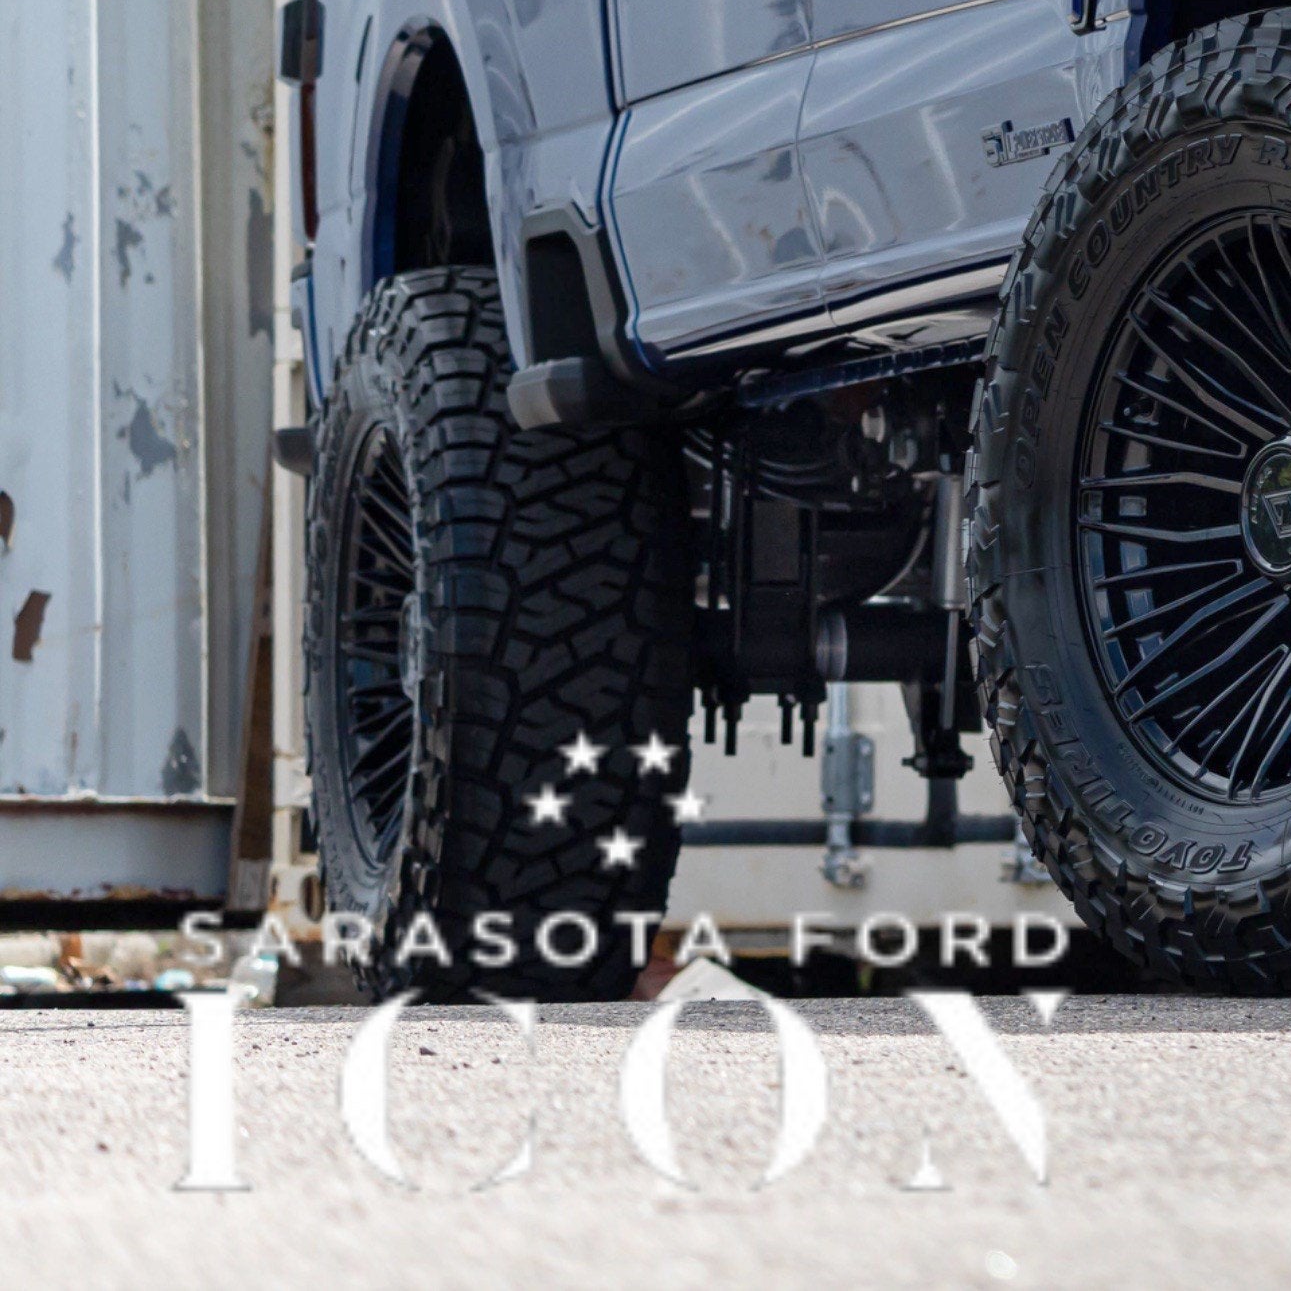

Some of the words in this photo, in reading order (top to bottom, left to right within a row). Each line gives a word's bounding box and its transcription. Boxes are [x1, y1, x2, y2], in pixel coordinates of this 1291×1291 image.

[1012, 297, 1070, 490] OPEN
[1066, 132, 1243, 302] COUNTRY
[1022, 662, 1136, 834] TIRES
[1128, 822, 1256, 875] TOYO
